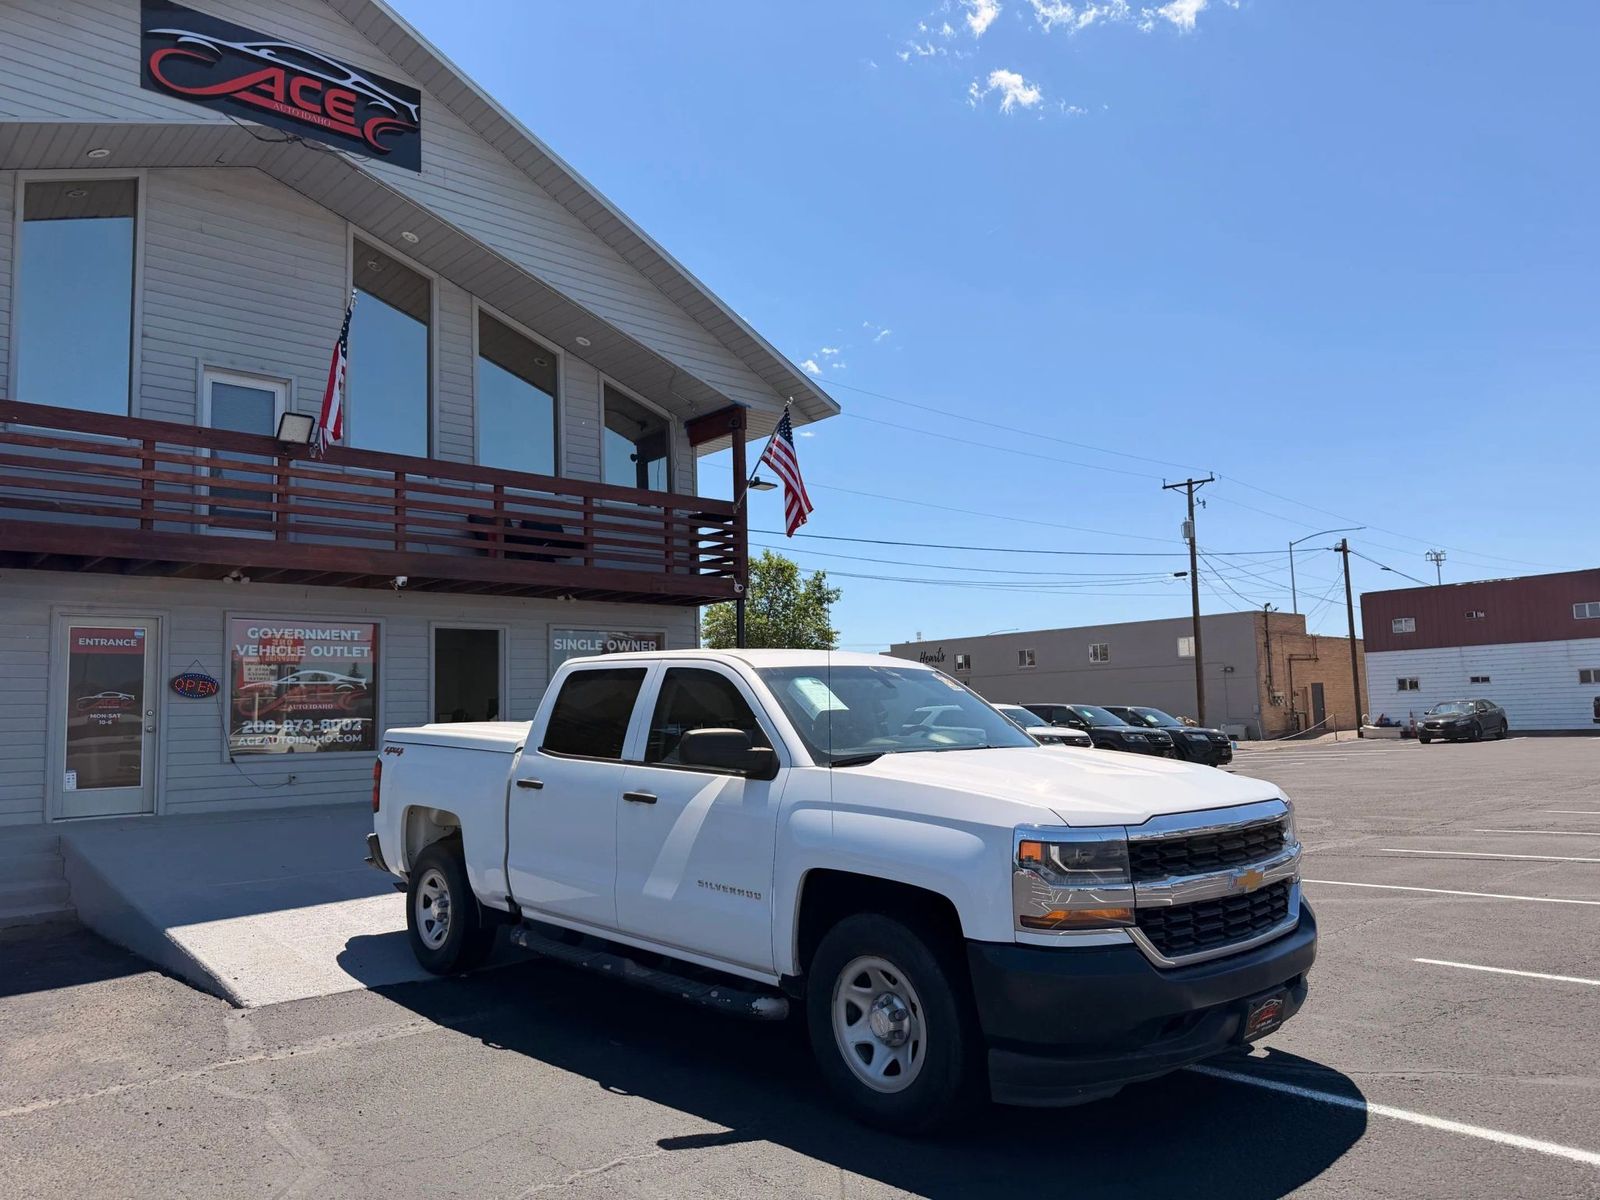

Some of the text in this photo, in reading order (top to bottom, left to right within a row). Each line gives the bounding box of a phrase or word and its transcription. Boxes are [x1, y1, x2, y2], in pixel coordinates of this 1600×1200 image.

[243, 66, 358, 126] ACE
[273, 102, 331, 127] AUTO IDAHO
[247, 627, 361, 641] GOVERNMENT
[78, 637, 138, 647] ENTRANCE
[553, 638, 657, 652] SINGLE OWNER
[236, 644, 371, 658] VEHICLE OUTLET
[175, 679, 217, 693] OPEN
[238, 734, 362, 746] ACEAUTOIDAHO.COM
